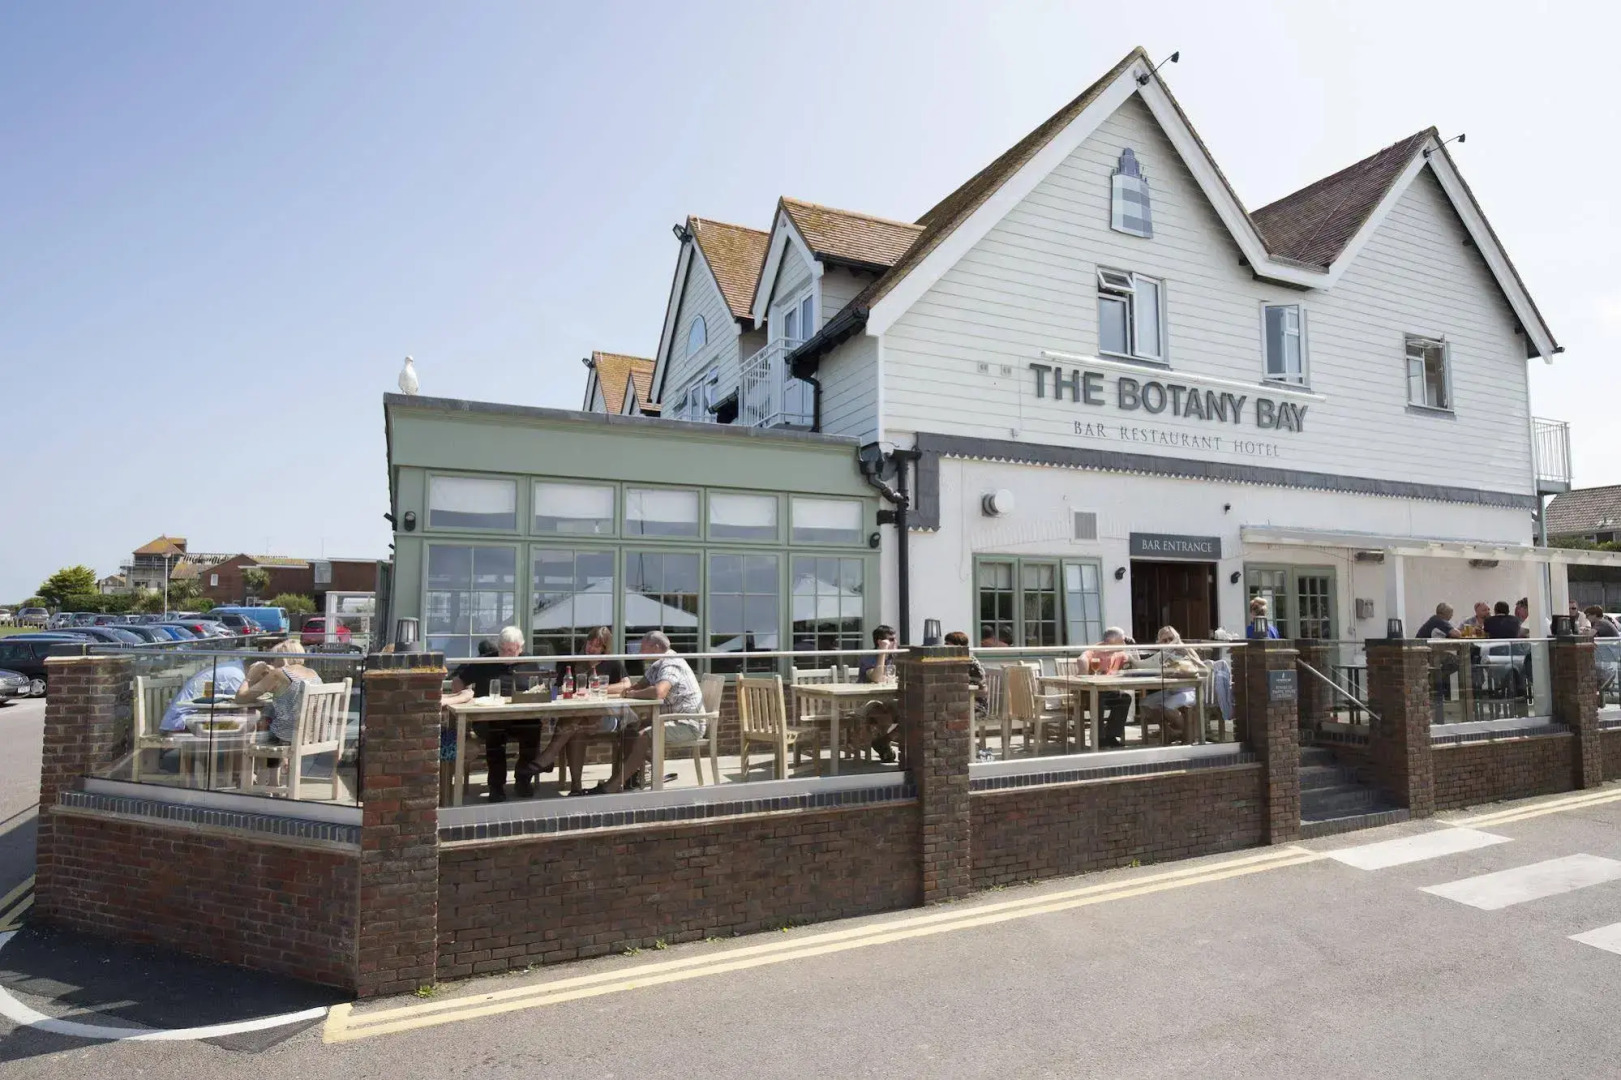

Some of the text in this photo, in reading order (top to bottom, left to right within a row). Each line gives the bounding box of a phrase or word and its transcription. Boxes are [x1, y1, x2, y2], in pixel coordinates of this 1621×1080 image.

[1029, 362, 1309, 433] THE BOTANY BAY
[1074, 420, 1280, 457] BAR RESTAURANT HOTEL
[1142, 539, 1213, 553] BAR ENTRANCE
